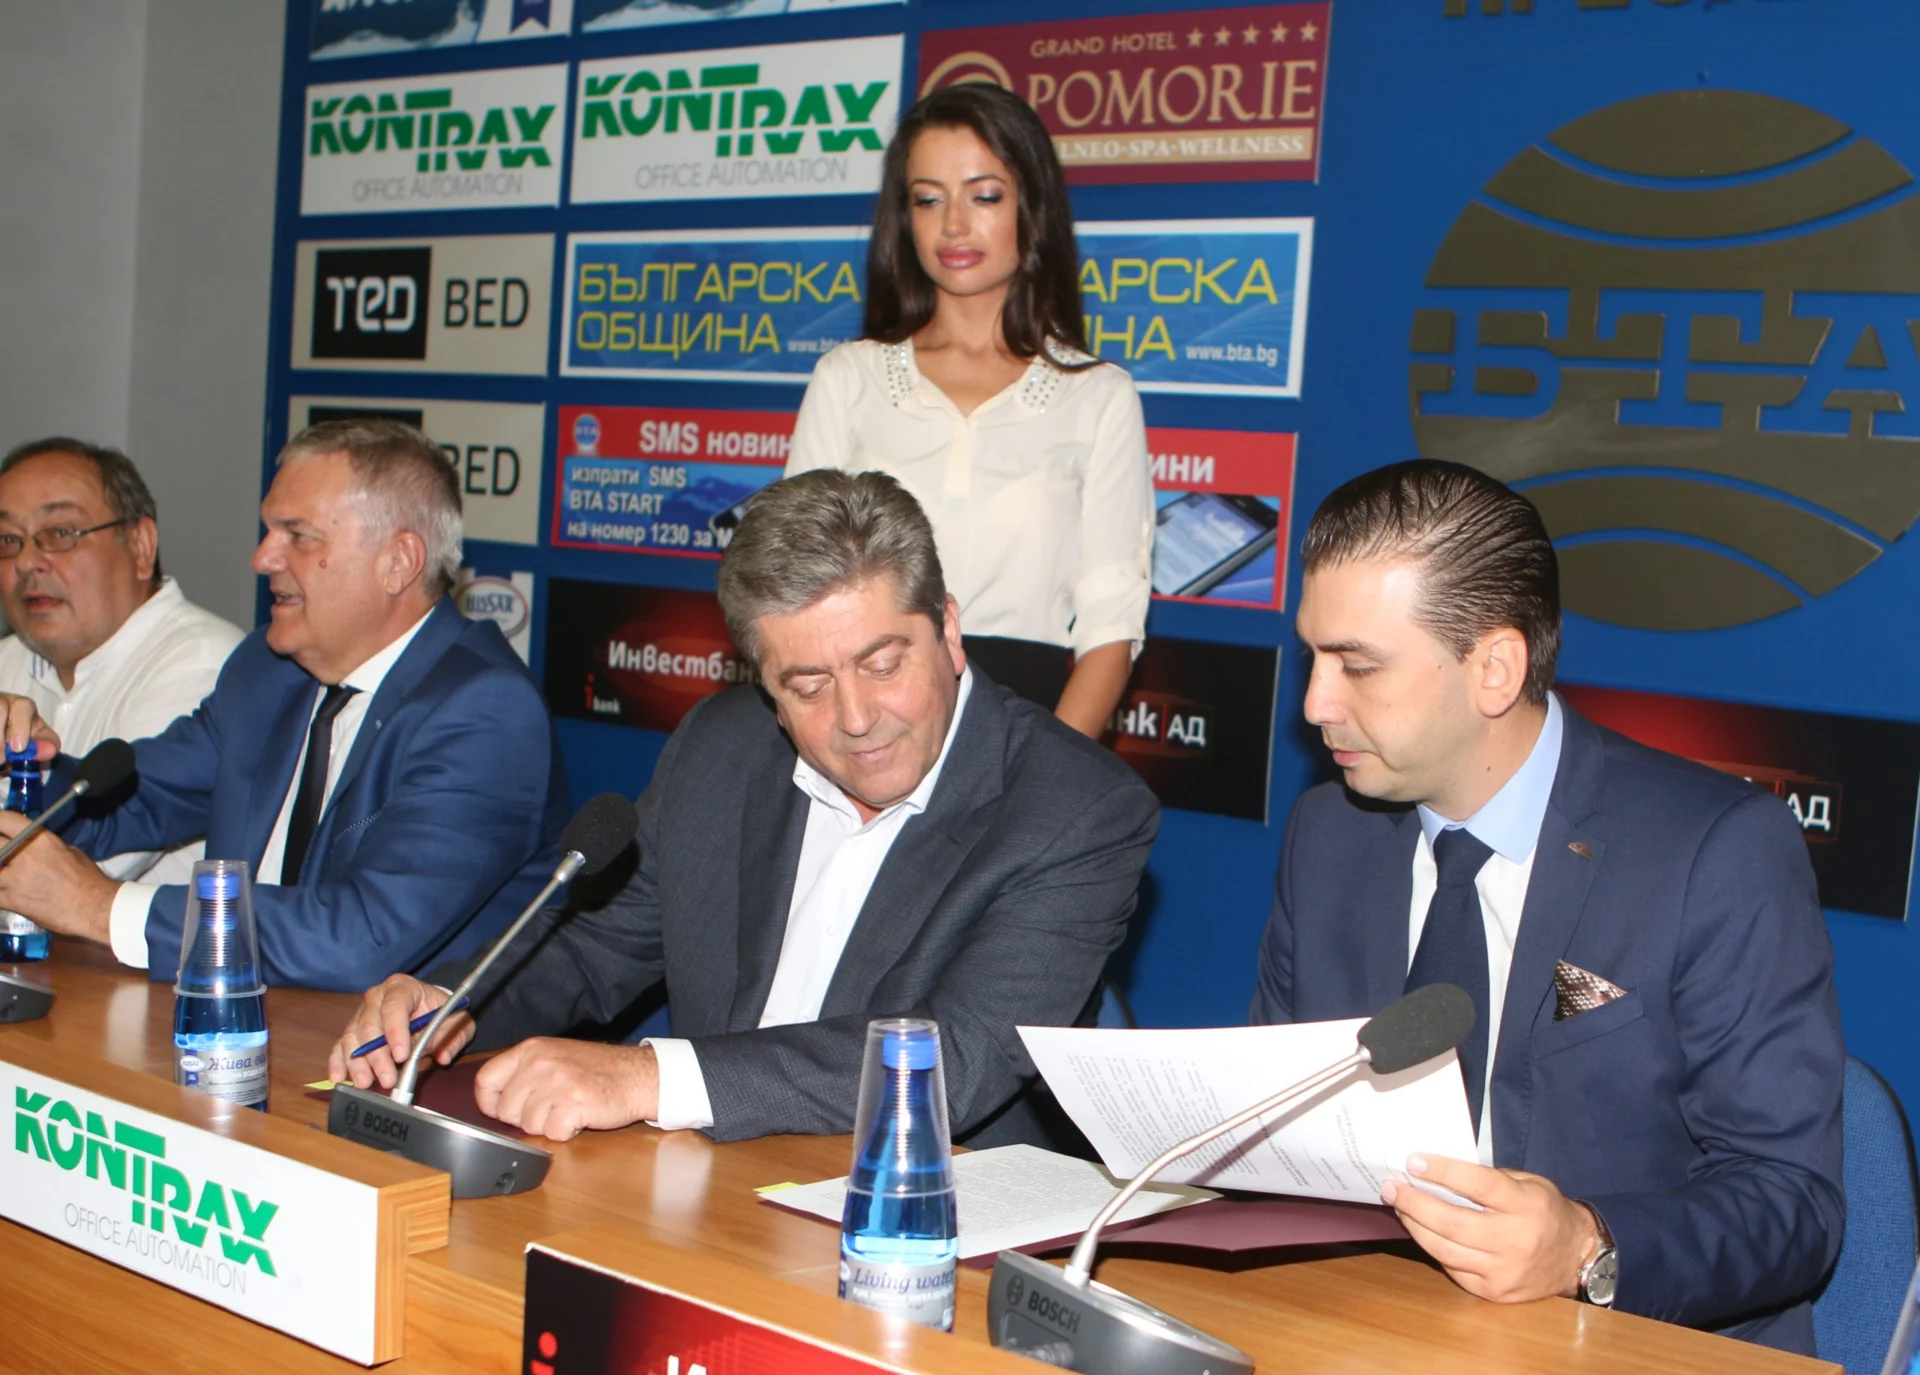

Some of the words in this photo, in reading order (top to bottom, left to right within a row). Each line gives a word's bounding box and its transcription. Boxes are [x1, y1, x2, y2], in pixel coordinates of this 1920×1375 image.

[1030, 36, 1105, 58] GRAND
[1111, 31, 1177, 53] HOTEL
[582, 63, 890, 157] KONTRAX
[1027, 60, 1317, 128] POMORIE
[310, 88, 556, 173] KONTRAX
[1061, 140, 1120, 160] LNEO
[353, 175, 405, 200] OFFICE
[409, 172, 522, 199] AUTOMATION
[635, 160, 702, 189] OFFICE
[703, 156, 847, 187] AUTOMATION
[578, 262, 861, 303] БЪЛГАРСКА
[1079, 257, 1279, 305] АРСКА
[444, 277, 530, 328] BED
[576, 312, 781, 361] ОБЩИНА
[1186, 342, 1279, 367] www.bta.bg
[638, 420, 700, 456] SMS
[706, 431, 794, 460] новин
[572, 466, 639, 488] изпрати
[648, 465, 687, 489] SMS
[1148, 453, 1216, 484] ини
[569, 489, 604, 512] BTA
[606, 491, 664, 515] START
[567, 520, 587, 538] на
[591, 523, 646, 546] номер
[651, 522, 690, 547] 1230
[693, 530, 713, 548] за
[1167, 713, 1206, 747] АД
[363, 1111, 410, 1142] BOSCH
[15, 1085, 280, 1278] KONTRAX
[64, 1202, 122, 1246] OFFICE
[126, 1228, 248, 1296] AUTOMATION
[853, 1267, 912, 1294] Living
[1028, 1290, 1082, 1335] BOSCH
